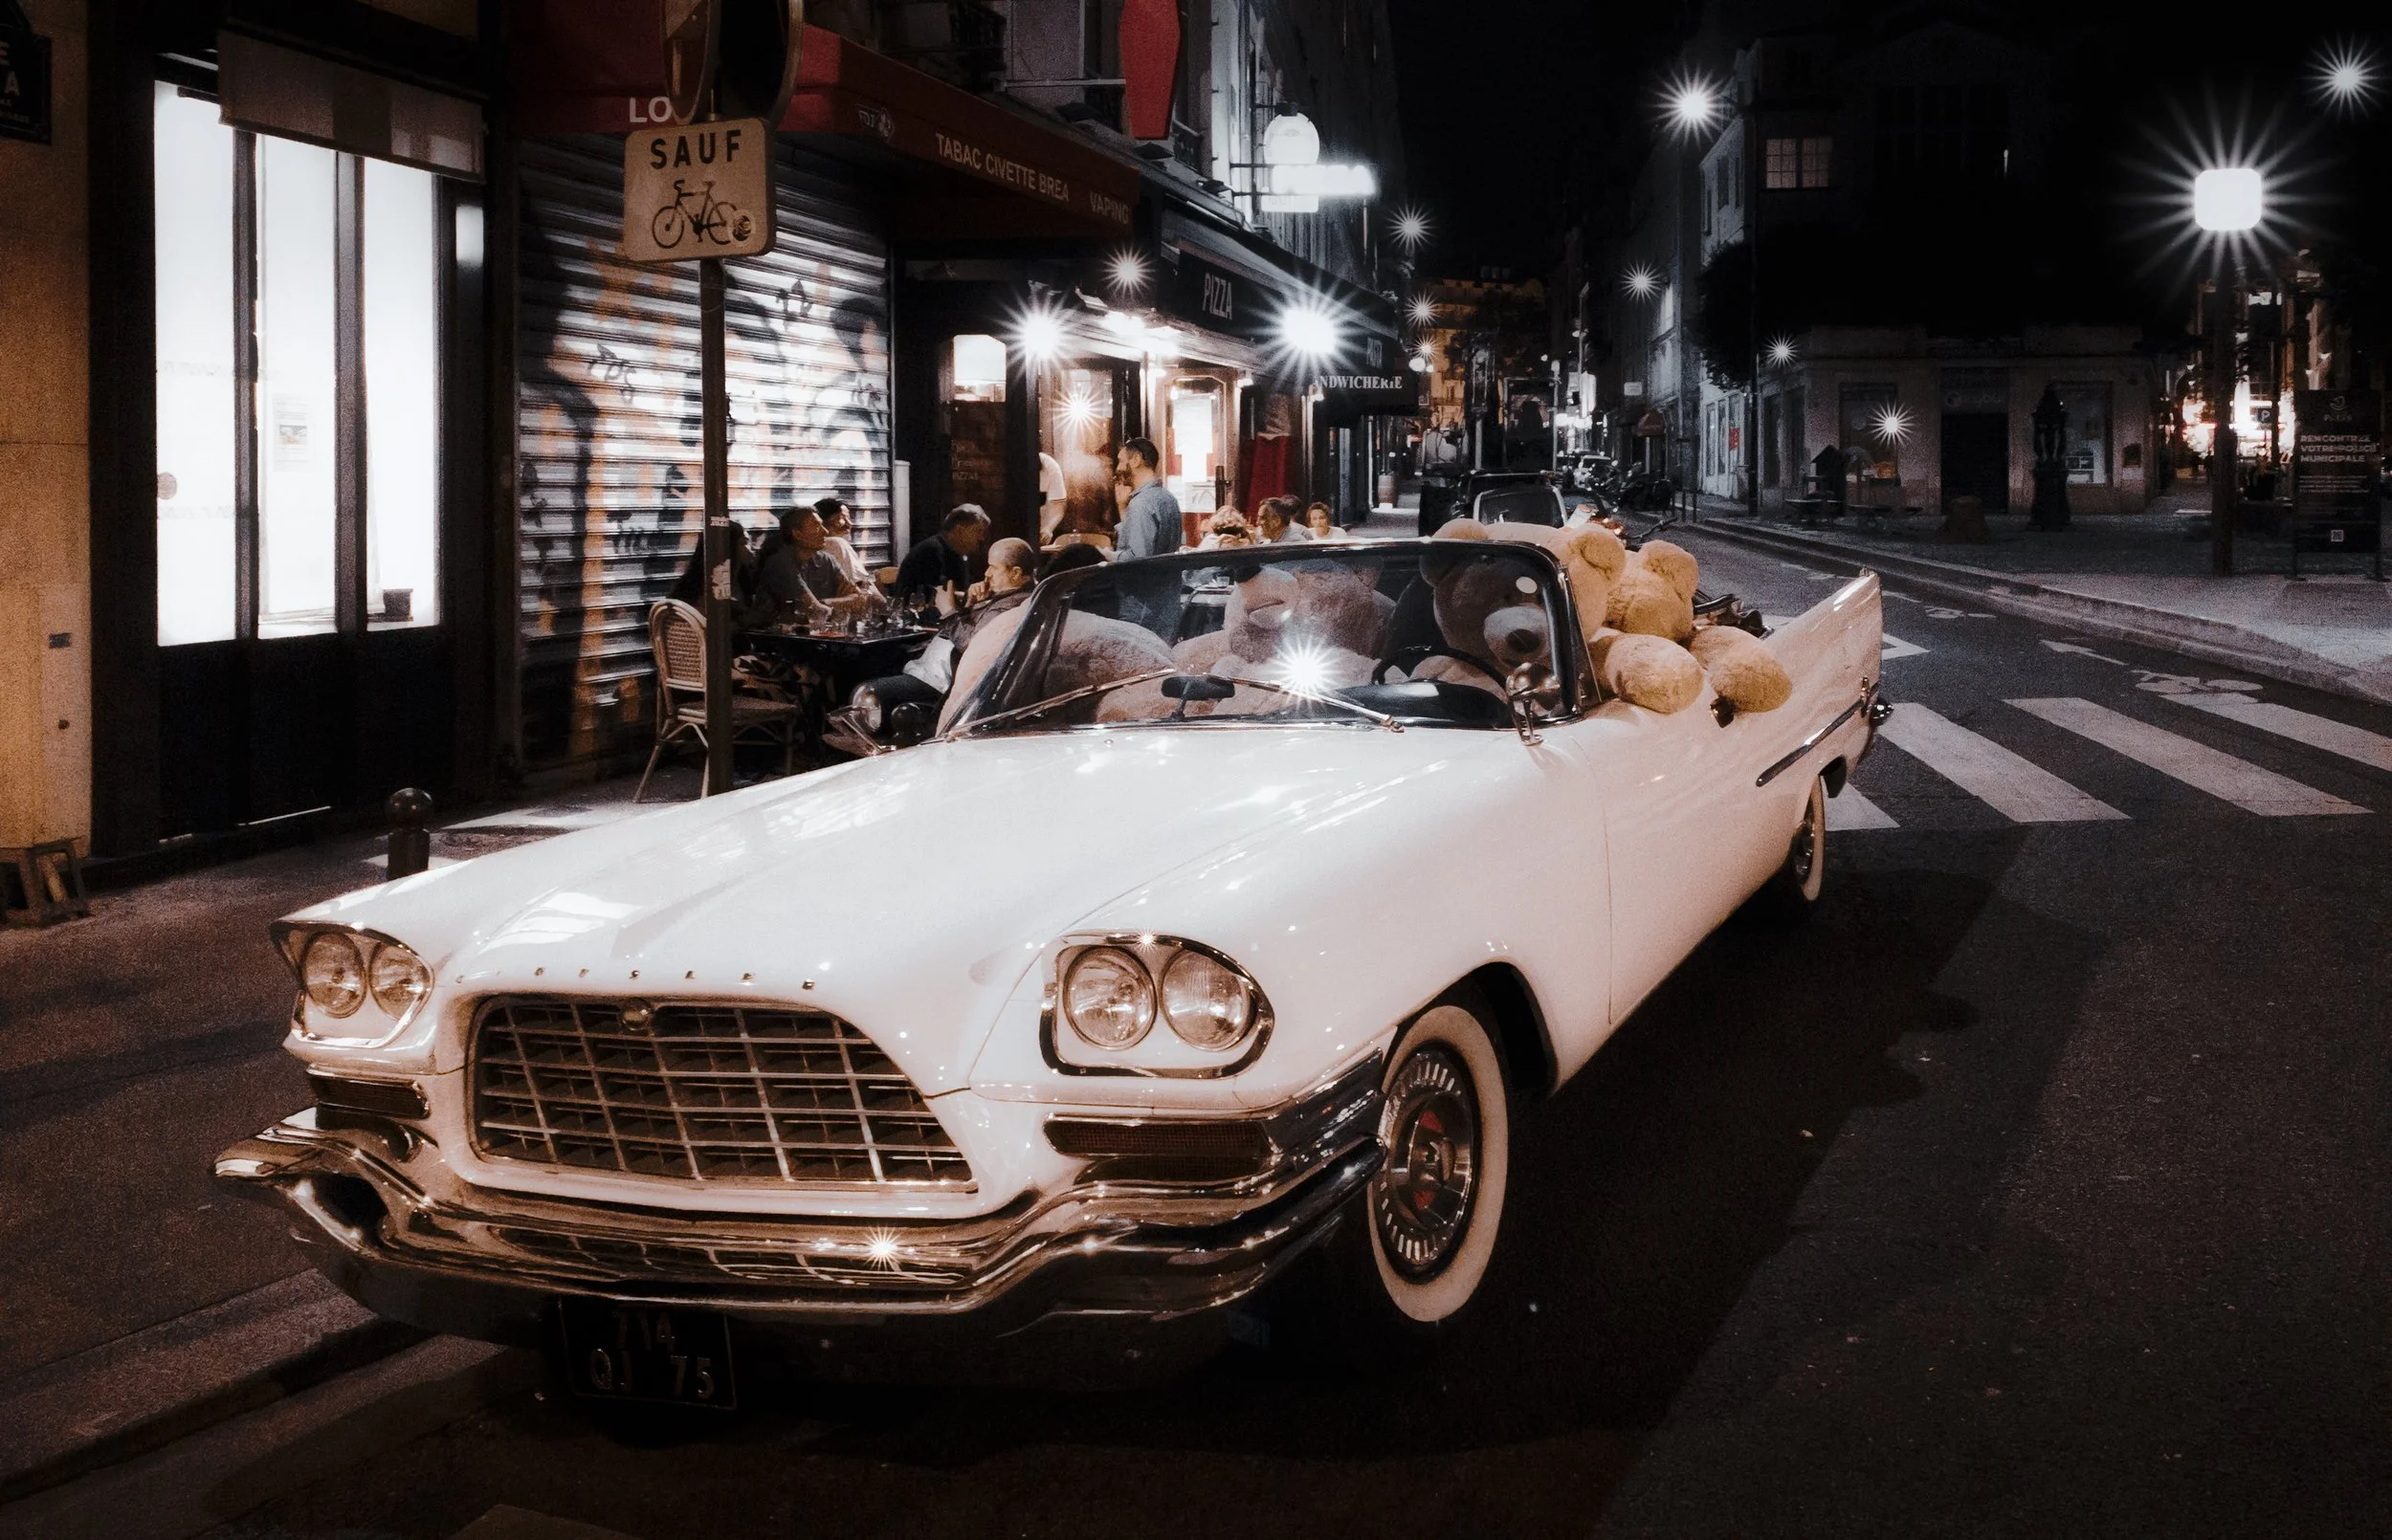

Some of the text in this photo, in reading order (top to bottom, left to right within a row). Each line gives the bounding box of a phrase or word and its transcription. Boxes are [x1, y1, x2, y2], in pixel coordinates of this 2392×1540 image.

[650, 129, 742, 170] SAUF
[935, 132, 1070, 202] TABAC CIVETTE BREA
[1089, 189, 1129, 225] VAPING
[1202, 272, 1232, 321] PIZZA
[1312, 375, 1404, 390] NDWICHERIE
[2300, 454, 2366, 463] MUNICIPALE
[669, 1354, 716, 1400] 75
